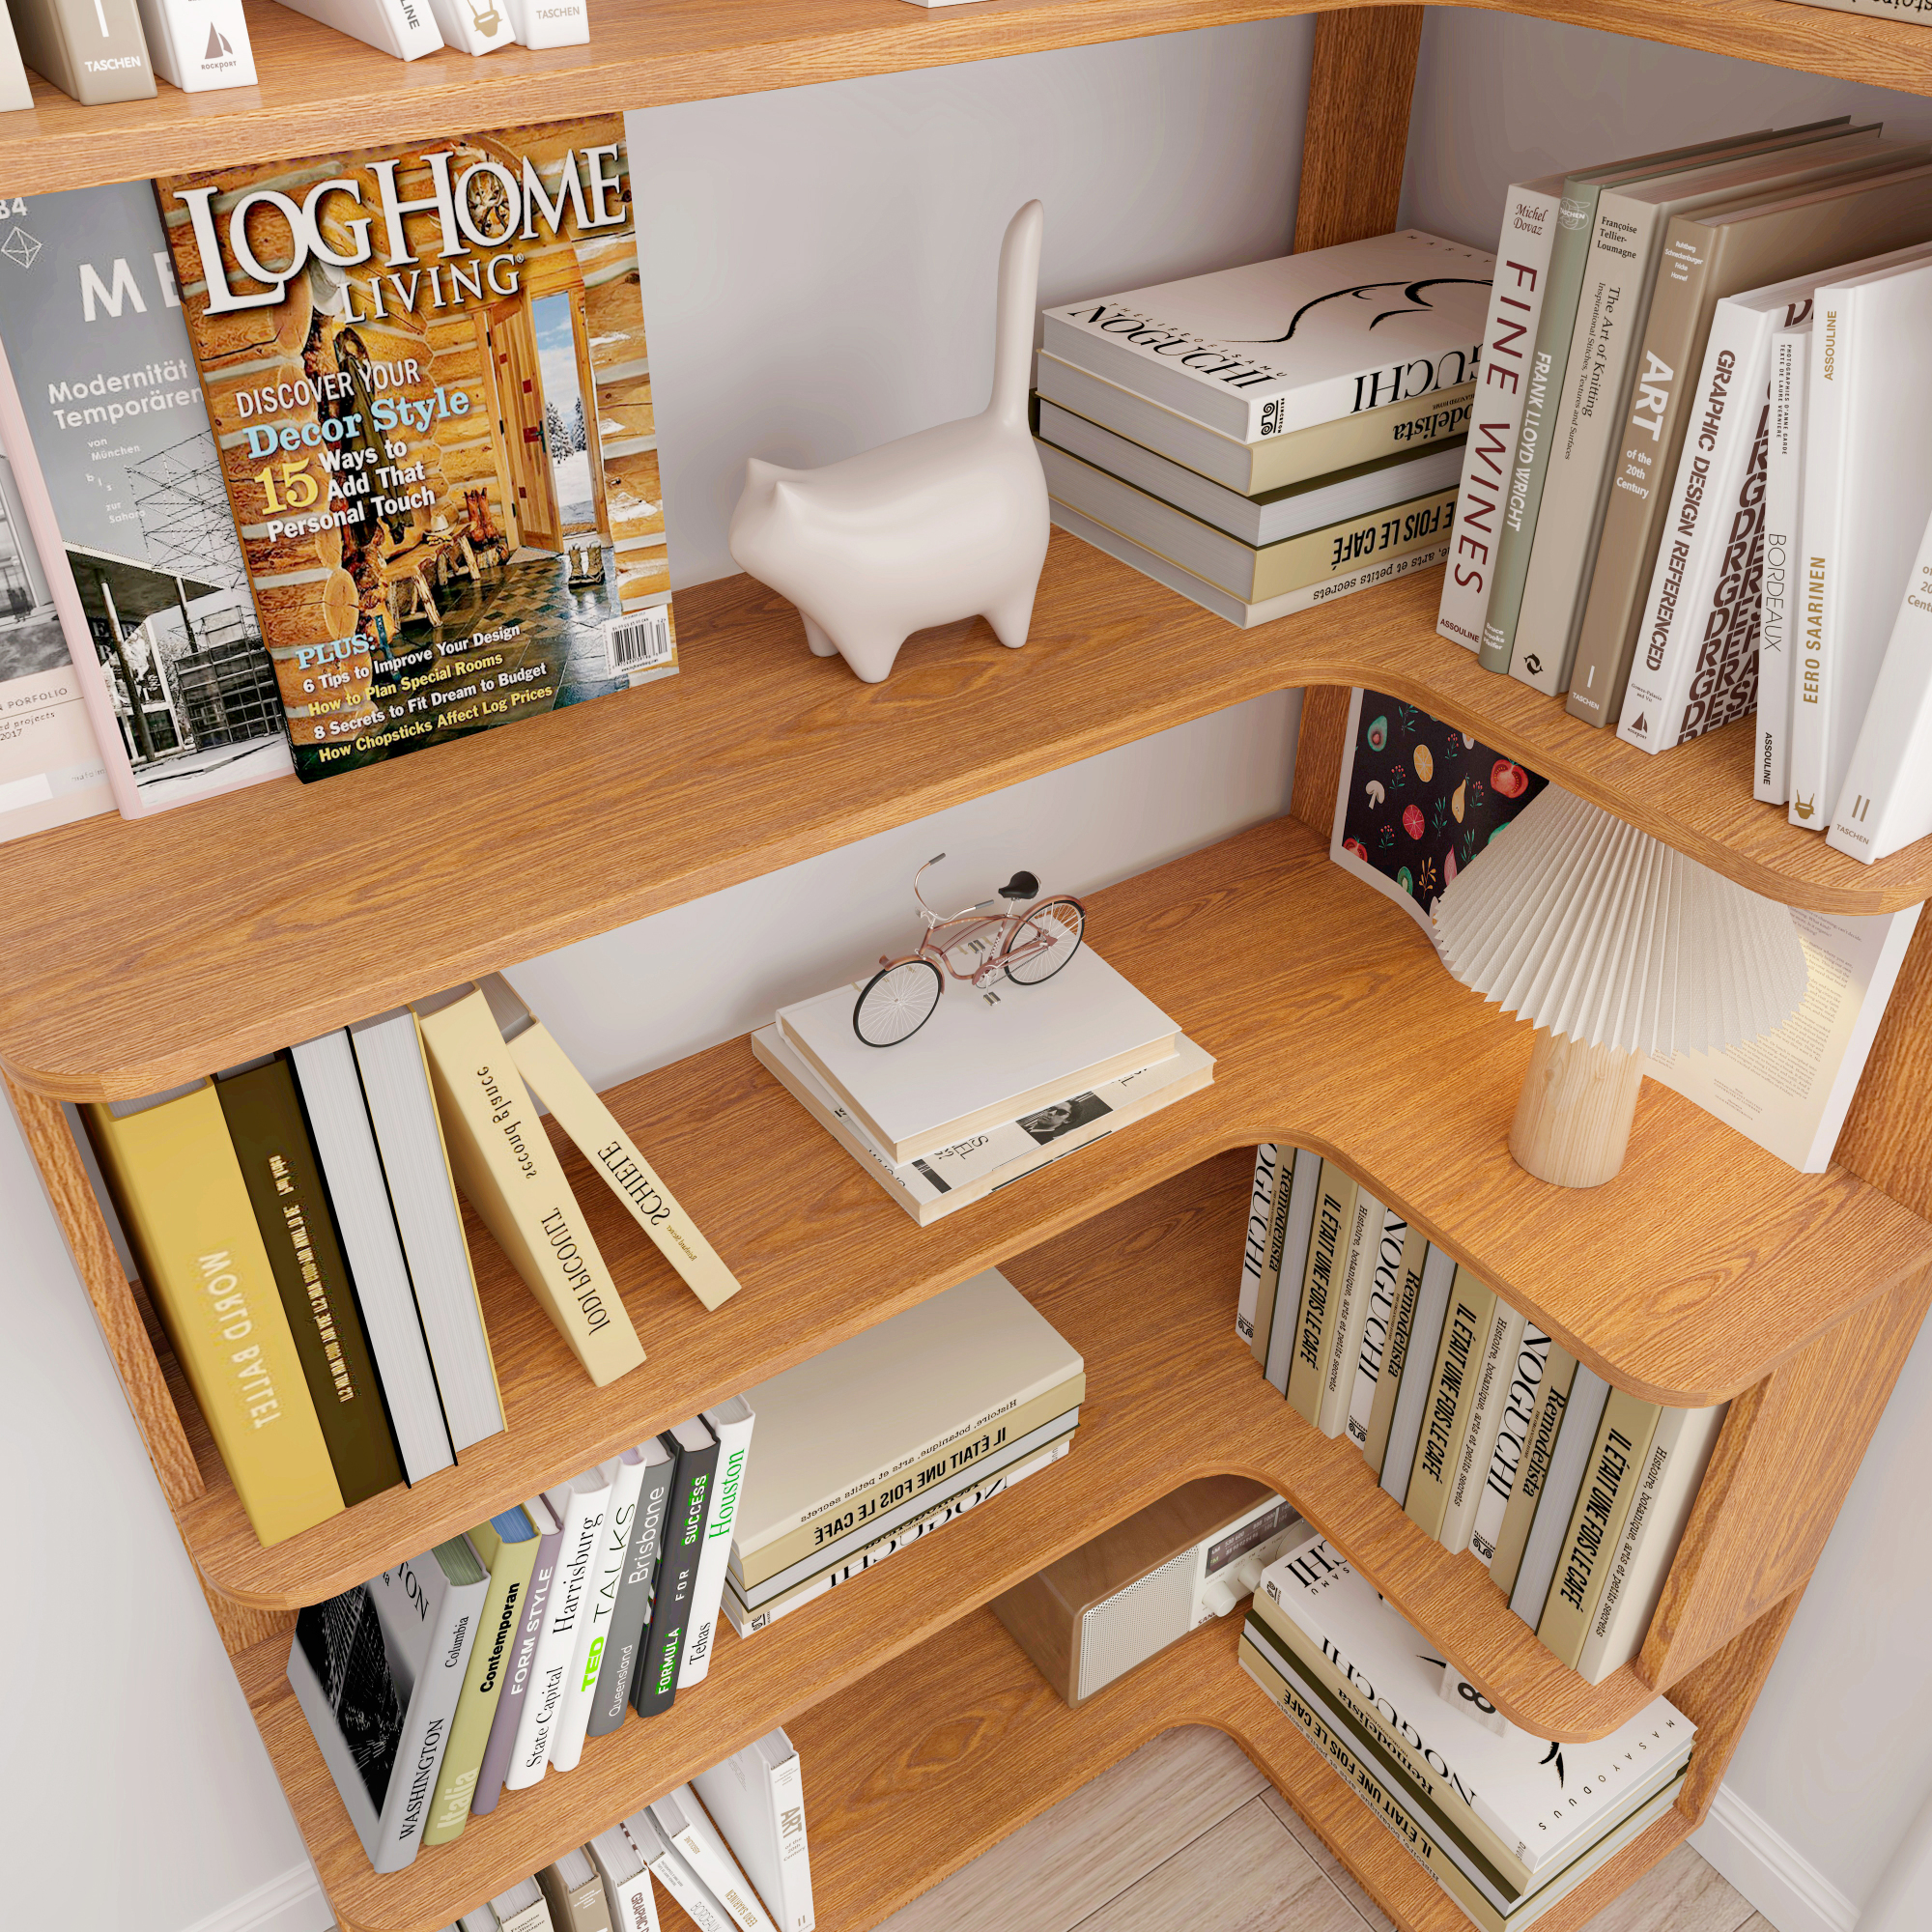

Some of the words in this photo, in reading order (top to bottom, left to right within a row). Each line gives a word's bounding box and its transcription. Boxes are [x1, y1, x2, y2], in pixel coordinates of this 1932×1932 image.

[536, 6, 581, 20] TASCHEN
[84, 55, 142, 72] TASCHEN
[1513, 217, 1544, 236] Dovaz
[1515, 203, 1548, 222] Michel
[1601, 215, 1638, 235] Françoise
[1596, 240, 1637, 259] Loumagne
[1587, 281, 1605, 337] Inspirational
[1605, 286, 1622, 314] The
[1067, 304, 1277, 389] NOGUCHI
[1486, 259, 1538, 395] FINE
[1599, 315, 1614, 342] Art
[1824, 310, 1837, 382] ASSOULINE
[1596, 343, 1608, 360] of
[48, 358, 188, 406] Modernität
[235, 371, 355, 419] DISCOVER
[357, 358, 421, 394] YOUR
[1527, 350, 1552, 408] FRANK
[1575, 373, 1589, 408] Textures
[1581, 360, 1605, 418] Knitting
[1632, 350, 1674, 442] ART
[1570, 409, 1580, 425] and
[1697, 349, 1737, 452] GRAPHIC
[242, 411, 363, 460] Decor
[370, 386, 470, 434] Style
[1518, 407, 1543, 465] LLOYD
[87, 438, 108, 449] von
[91, 443, 141, 462] München
[318, 446, 379, 473] Ways
[384, 439, 408, 458] to
[1564, 428, 1577, 462] Surfaces
[1626, 448, 1637, 461] of
[1637, 452, 1653, 467] the
[253, 457, 320, 516] 15
[327, 472, 370, 502] Add
[375, 460, 426, 489] That
[1616, 476, 1650, 500] Century
[1625, 464, 1646, 480] 20th
[266, 504, 367, 544] Personal
[369, 485, 436, 519] Touch
[1453, 422, 1511, 594] WINES
[1506, 466, 1532, 532] WRIGHT
[1678, 455, 1711, 537] DESIGN
[1378, 518, 1402, 551] LE
[1404, 505, 1441, 542] FOIS
[1330, 527, 1377, 572] CAFÉ
[1396, 559, 1408, 572] et
[1410, 552, 1435, 568] arts
[1313, 578, 1357, 601] secrets
[1359, 563, 1394, 585] petits
[1764, 533, 1787, 653] BORDEAUX
[1646, 539, 1690, 672] REFERENCED
[1804, 556, 1826, 652] SAARINEN
[1439, 617, 1480, 643] ASSOULINE
[296, 633, 377, 670] PLUS:
[302, 678, 316, 694] 6
[317, 670, 351, 692] Tips
[353, 665, 370, 681] to
[373, 648, 434, 676] Improve
[436, 637, 469, 657] Your
[472, 624, 522, 652] Design
[8, 687, 69, 708] PORFOLIO
[308, 699, 342, 717] How
[345, 690, 362, 706] to
[365, 681, 398, 702] Plan
[400, 662, 453, 695] Special
[454, 652, 503, 676] Rooms
[1572, 691, 1601, 710] TASCHEN
[1803, 659, 1820, 704] EERO
[14, 712, 55, 728] projects
[314, 724, 327, 741] 8
[328, 708, 386, 736] Secrets
[388, 703, 405, 720] to
[408, 696, 428, 714] Fit
[430, 684, 478, 709] Dream
[480, 677, 497, 694] to
[497, 662, 548, 689] Budget
[318, 745, 352, 763] How
[355, 719, 434, 753] Chopsticks
[436, 705, 480, 730] Affect
[482, 697, 509, 718] Log
[509, 685, 554, 708] Prices
[1763, 731, 1774, 786] ASSOULINE
[1835, 823, 1870, 846] TASCHEN
[1323, 1193, 1342, 1213] IL
[1318, 1209, 1342, 1258] ÉTAIT
[1313, 1250, 1333, 1286] UNE
[1308, 1278, 1328, 1317] FOIS
[1456, 1302, 1477, 1324] IL
[1305, 1310, 1322, 1336] LE
[1300, 1328, 1321, 1371] CAFÉ
[1448, 1319, 1476, 1370] ÉTAIT
[1440, 1360, 1463, 1399] UNE
[1434, 1389, 1458, 1429] FOIS
[1430, 1420, 1449, 1448] LE
[1607, 1427, 1633, 1451] IL
[1422, 1439, 1445, 1485] CAFÉ
[1596, 1444, 1632, 1497] ÉTAIT
[681, 1473, 709, 1546] SUCCESS
[1585, 1486, 1614, 1527] UNE
[1577, 1515, 1605, 1557] FOIS
[1619, 1542, 1634, 1565] arts
[552, 1513, 604, 1634] Harrisburg
[689, 1622, 711, 1665] Tehas
[708, 1448, 745, 1540] Houston
[1571, 1546, 1595, 1577] LE
[1615, 1565, 1628, 1577] et
[581, 1635, 605, 1692] TED
[593, 1503, 636, 1624] TALKS
[608, 1644, 634, 1718] Queensland
[628, 1486, 665, 1585] Brisbane
[674, 1569, 690, 1603] FOR
[1560, 1565, 1588, 1614] CAFÉ
[1606, 1570, 1623, 1605] petits
[510, 1636, 535, 1695] FORM
[526, 1566, 554, 1637] STYLE
[1596, 1602, 1613, 1637] secrets
[655, 1627, 682, 1696] FORMULA
[535, 1665, 564, 1723] Capital
[1283, 1689, 1313, 1727] CAFÉ
[1457, 1681, 1497, 1714] 8
[399, 1718, 445, 1841] WASHINGTON
[444, 1615, 469, 1669] Columbia
[1313, 1720, 1328, 1741] LE
[1321, 1635, 1477, 1810] NOGUCHI
[526, 1724, 550, 1769] State
[1329, 1740, 1356, 1776] FOIS
[1337, 1687, 1435, 1799] Remodelista
[436, 1767, 479, 1831] Italia
[1356, 1769, 1382, 1804] UNE
[781, 1805, 803, 1839] ART
[1382, 1800, 1418, 1844] ÉTAIT
[783, 1845, 806, 1862] Century
[787, 1843, 801, 1854] 20th
[1420, 1835, 1433, 1860] IL
[631, 1891, 649, 1928] GRAPHIC
